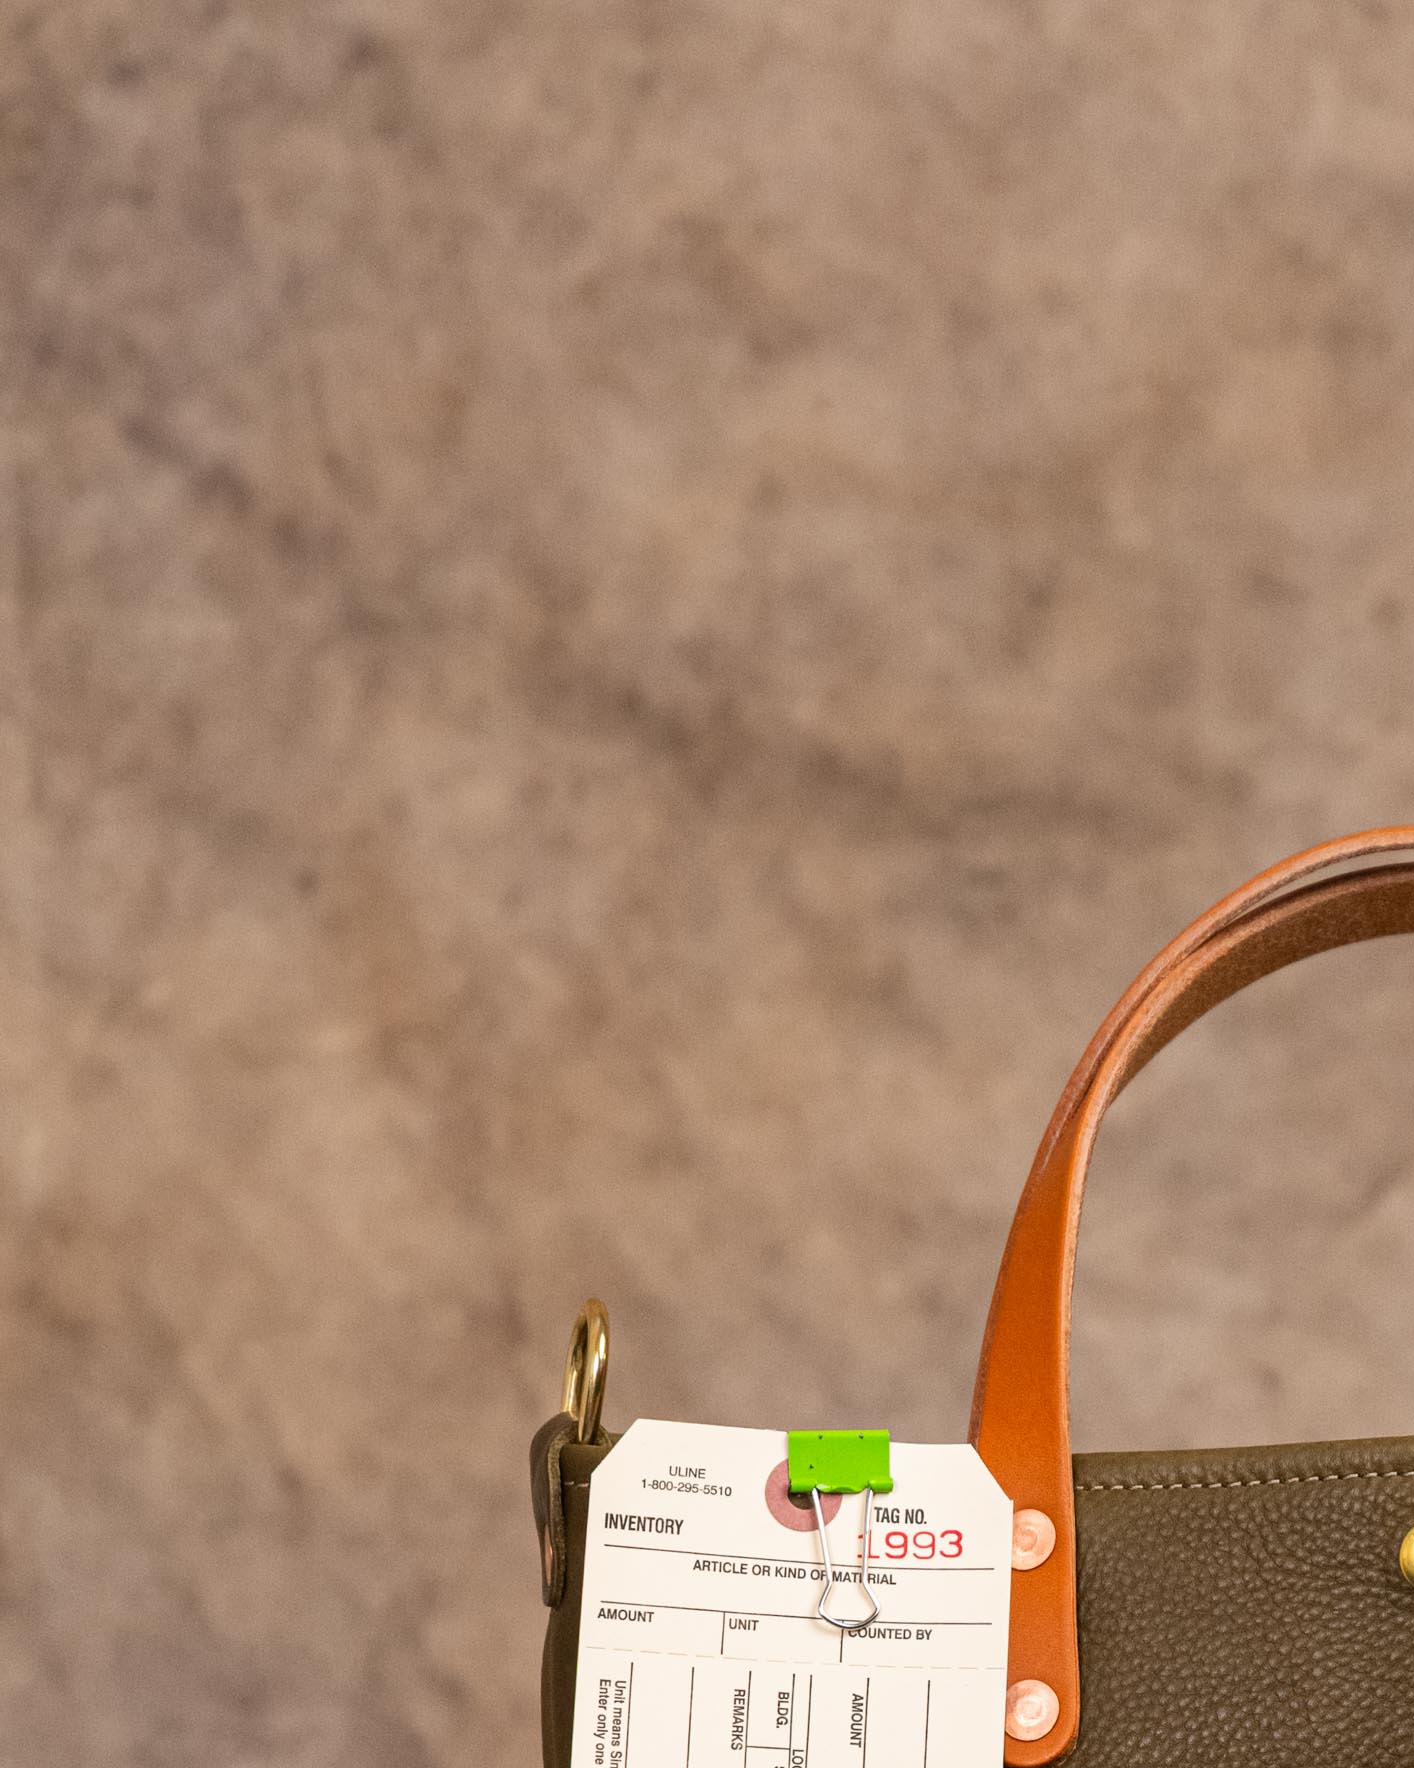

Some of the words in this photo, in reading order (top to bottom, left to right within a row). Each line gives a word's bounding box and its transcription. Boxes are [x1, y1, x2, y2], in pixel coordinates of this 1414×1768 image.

[669, 1465, 706, 1479] ULINE
[641, 1479, 732, 1497] 1-800-295-5510
[604, 1512, 684, 1536] INVENTORY
[874, 1506, 900, 1524] TAG
[905, 1508, 928, 1525] NO.
[693, 1559, 748, 1576] ARTICLE
[752, 1564, 771, 1578] OR
[775, 1565, 807, 1580] KIND
[598, 1608, 654, 1624] AMOUNT
[729, 1618, 759, 1632] UNIT
[916, 1629, 933, 1640] BY
[598, 1679, 611, 1711] Enter
[615, 1680, 627, 1705] Unit
[731, 1688, 746, 1750] REMARKS
[776, 1691, 790, 1729] BLDG.
[850, 1693, 864, 1748] AMOUNT
[593, 1714, 607, 1739] only
[611, 1708, 623, 1746] means
[595, 1742, 605, 1765] one
